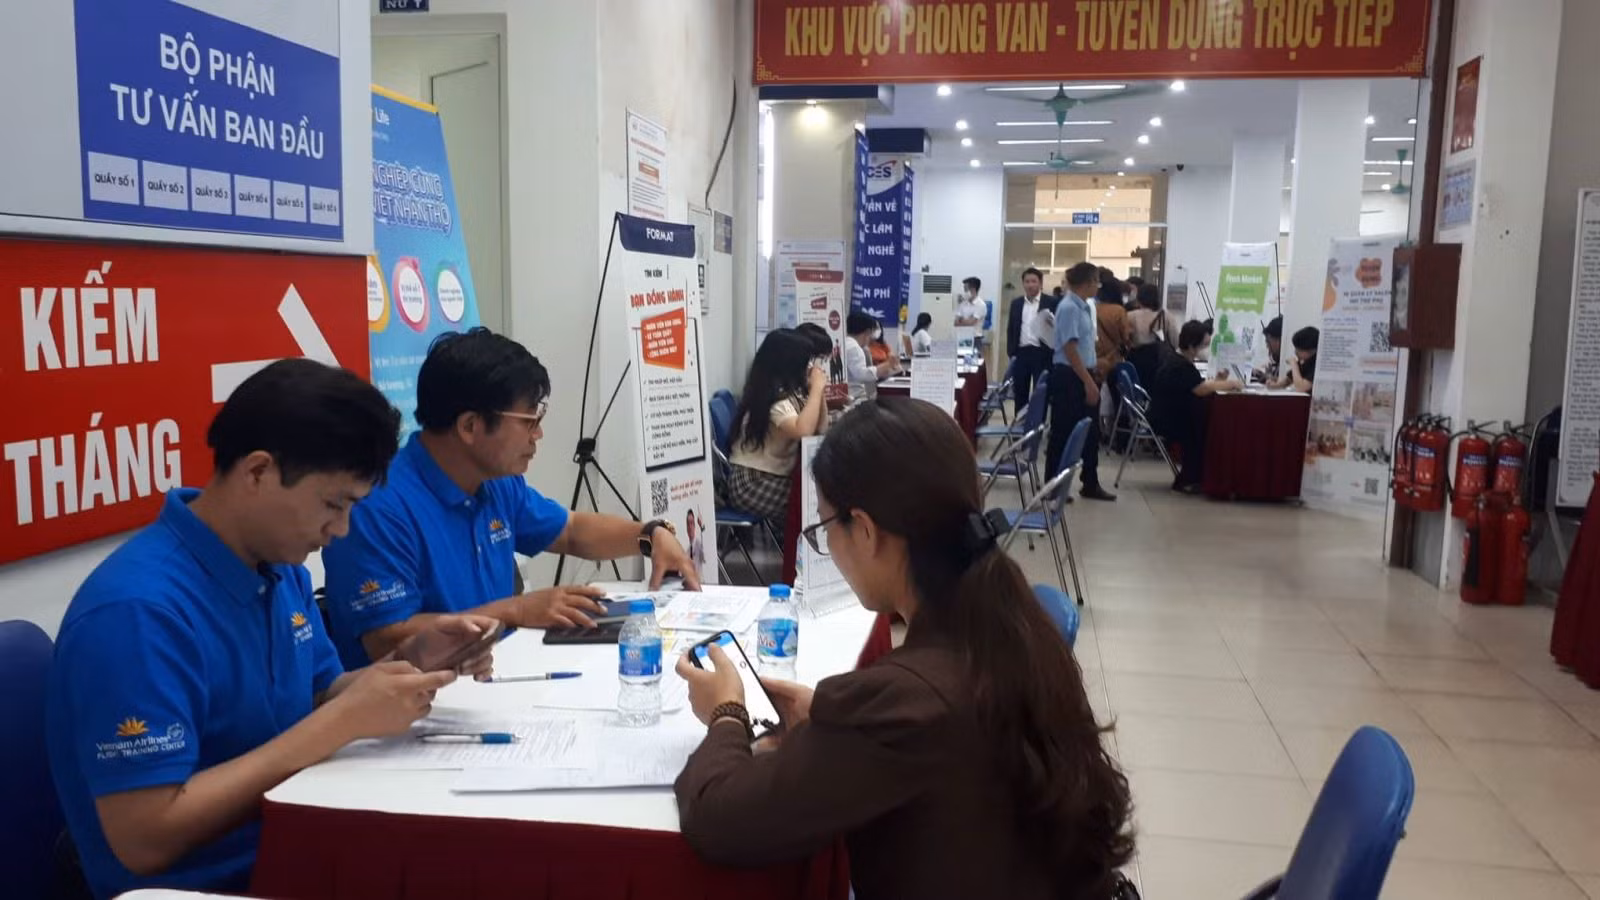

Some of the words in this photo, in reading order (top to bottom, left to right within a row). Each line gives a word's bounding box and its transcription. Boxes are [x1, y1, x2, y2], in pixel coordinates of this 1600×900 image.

[160, 31, 201, 84] BỘ
[208, 51, 276, 101] PHẬN
[785, 6, 834, 56] KHU
[843, 2, 892, 67] VỰC
[1168, 0, 1244, 62] DỤNG
[110, 82, 153, 126] TƯ
[159, 89, 217, 139] VẤN
[225, 109, 275, 150] BAN
[280, 115, 324, 160] ĐẦU
[646, 226, 674, 242] FORMAT
[20, 261, 159, 372] KIẾM
[4, 412, 182, 526] THÁNG
